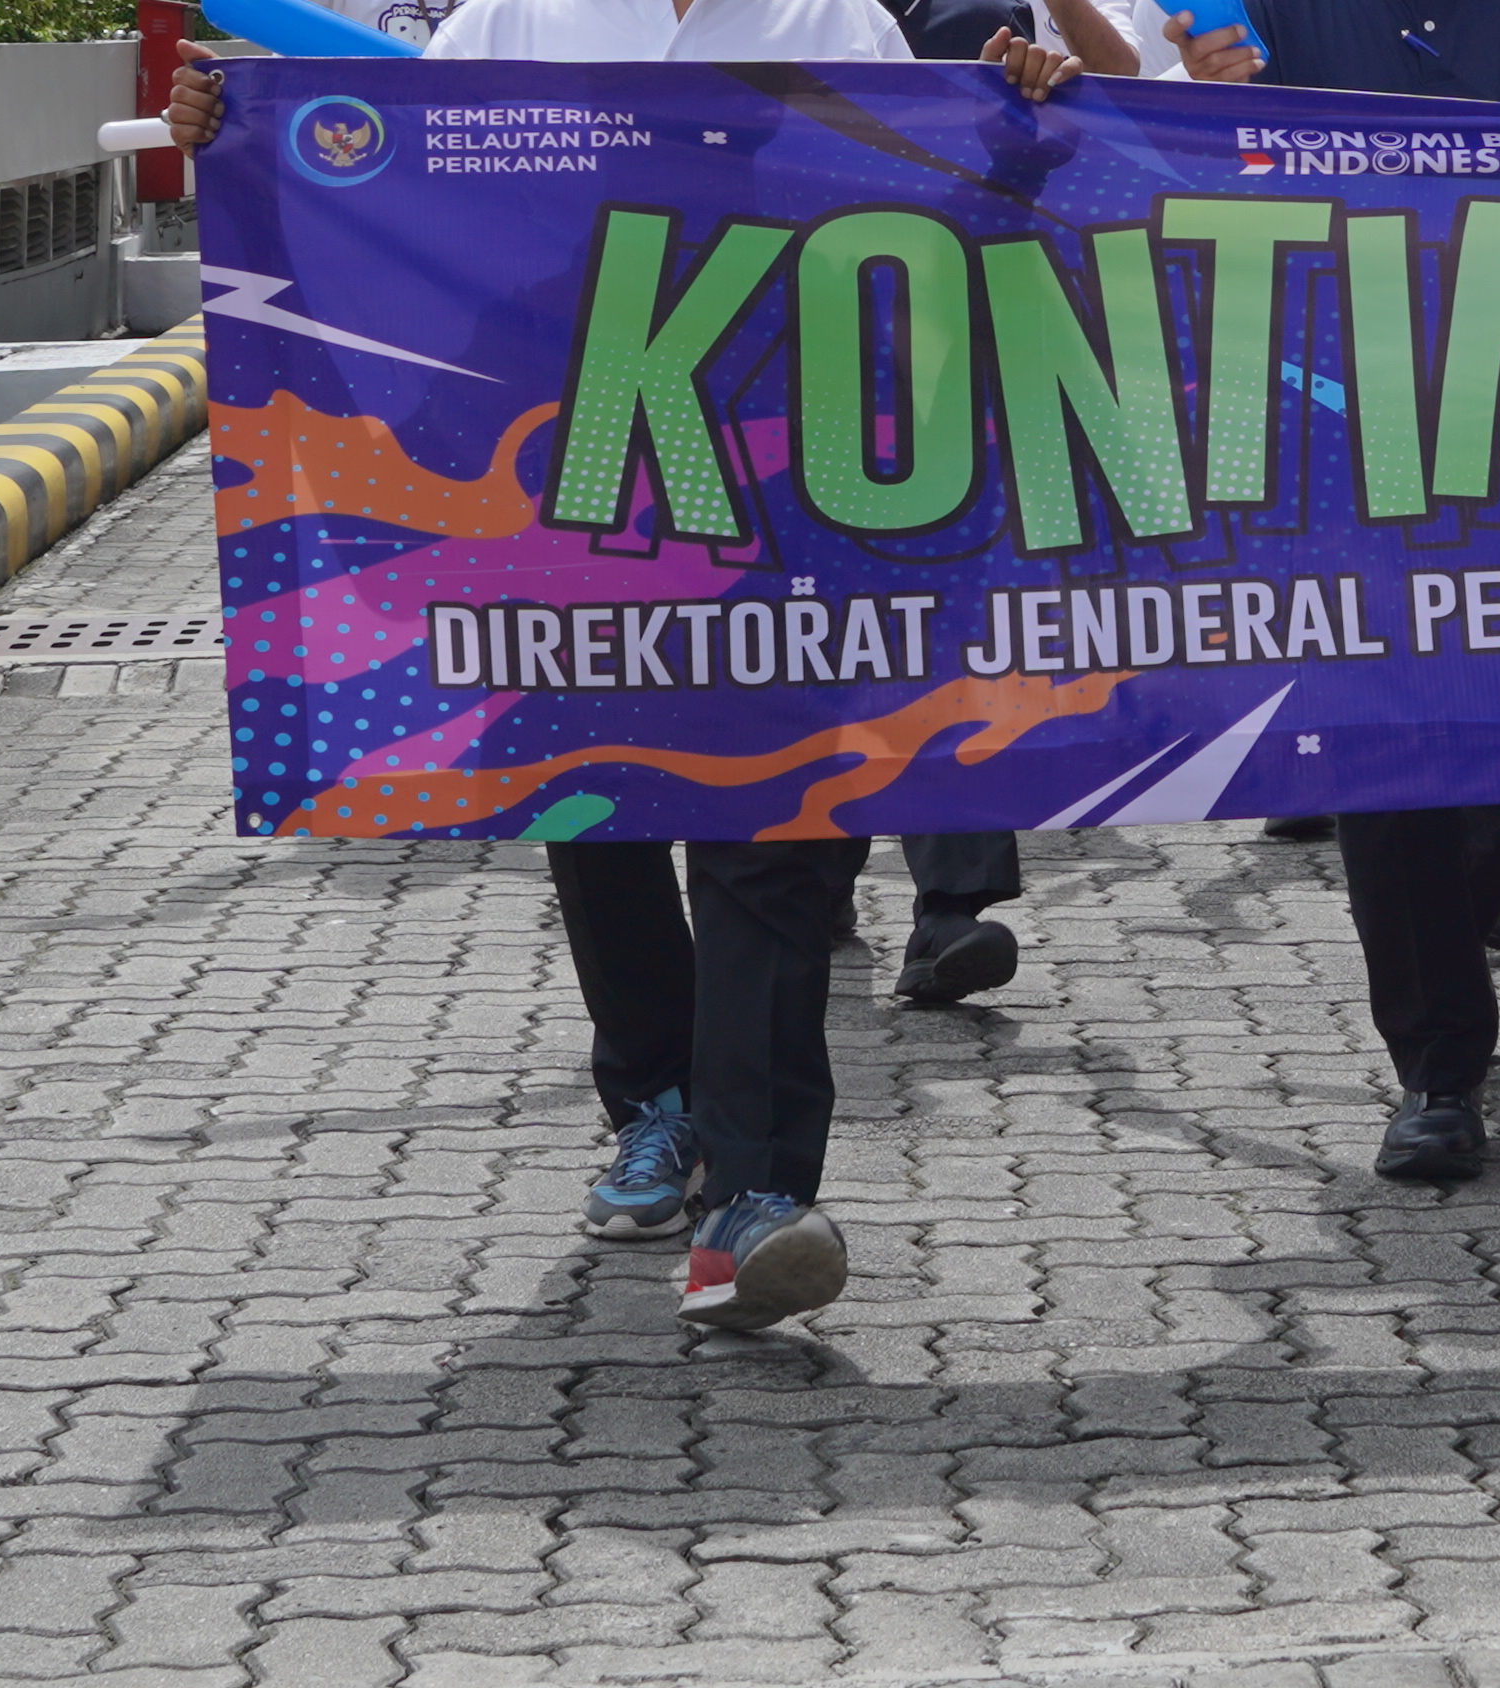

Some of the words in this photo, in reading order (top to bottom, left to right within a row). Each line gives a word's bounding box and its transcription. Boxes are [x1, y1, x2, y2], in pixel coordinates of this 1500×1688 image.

[425, 108, 635, 127] KEMENTERIAN
[426, 130, 581, 150] KELAUTAN
[590, 130, 652, 148] DAN
[1235, 127, 1465, 150] EKONOMI
[427, 155, 598, 174] PERIKANAN
[432, 595, 937, 688] DIREKTORAT
[966, 576, 1386, 678] JENDERAL
